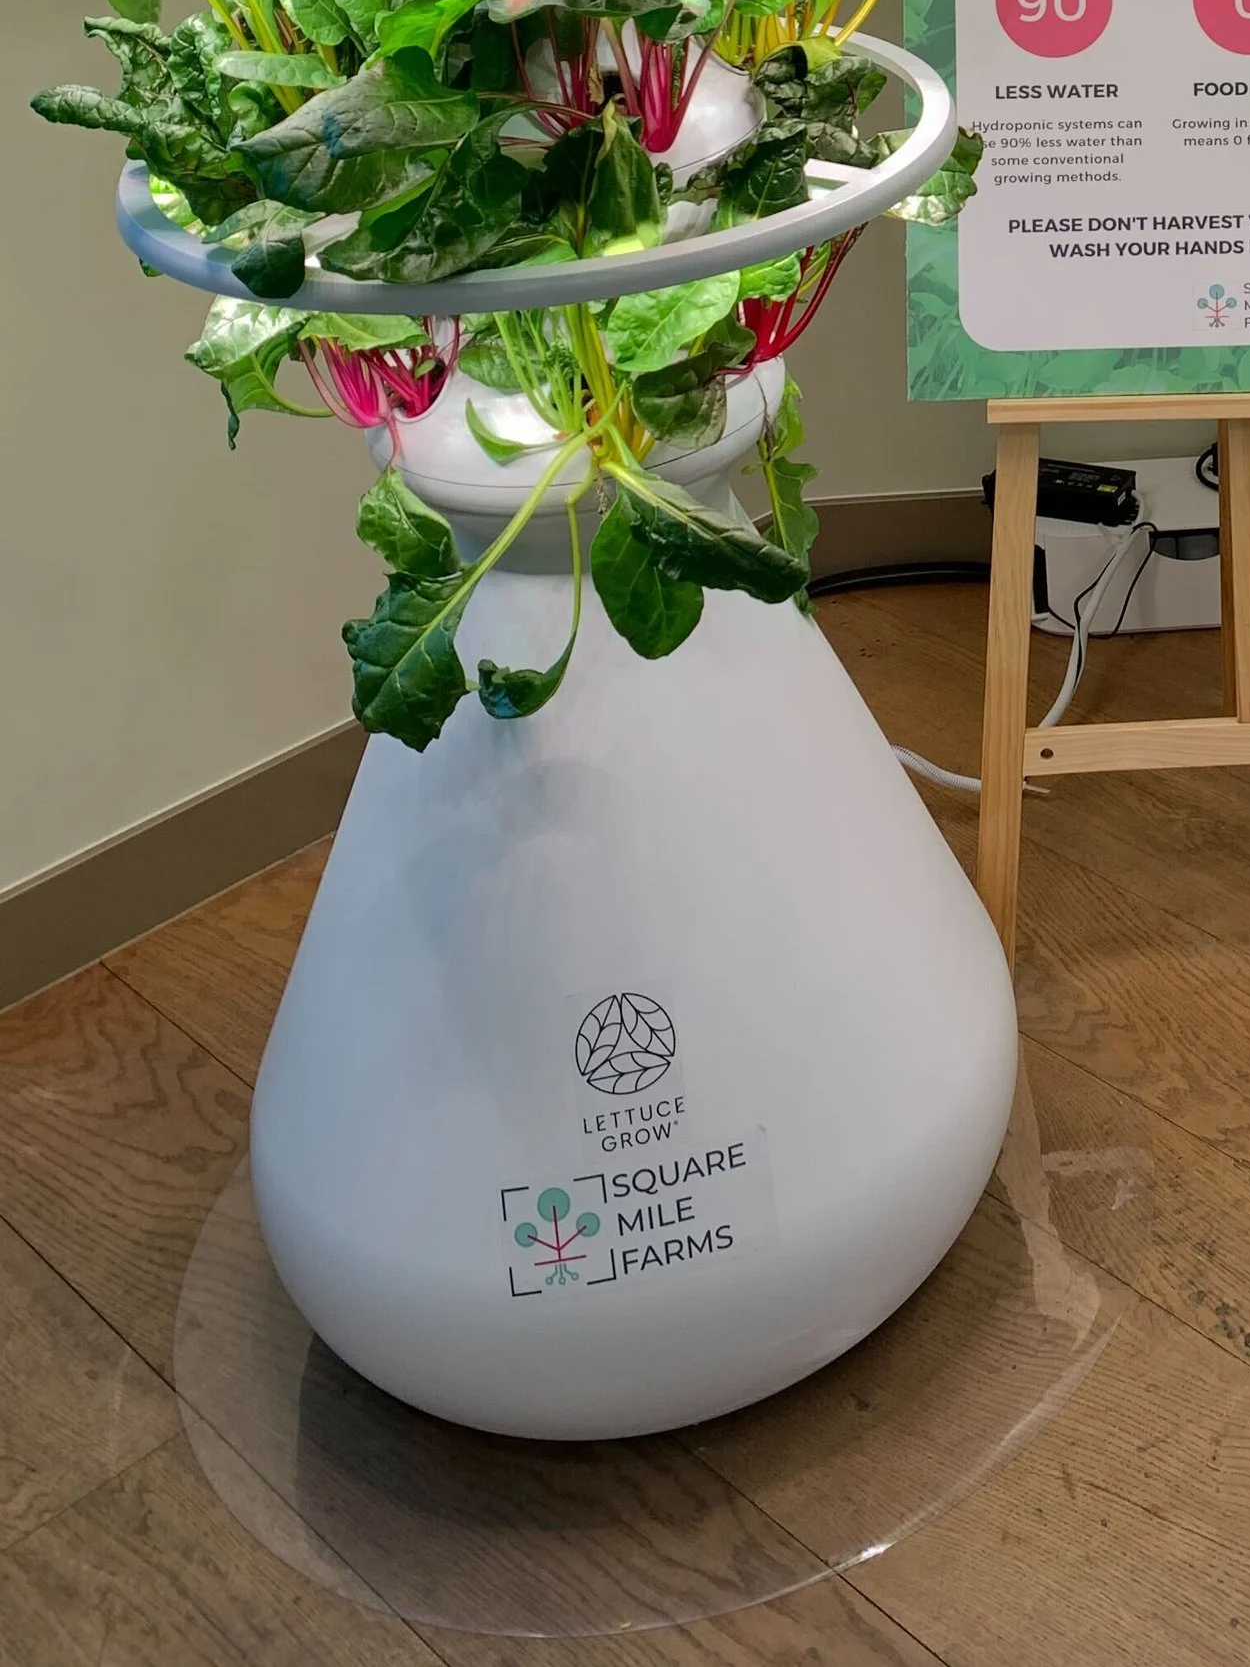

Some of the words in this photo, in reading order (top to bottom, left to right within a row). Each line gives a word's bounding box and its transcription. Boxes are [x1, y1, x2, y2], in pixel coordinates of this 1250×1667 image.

[995, 85, 1041, 100] LESS
[1047, 84, 1118, 98] WATER
[1194, 82, 1248, 96] FOOD
[972, 119, 1053, 133] Hydroponic
[1058, 120, 1113, 132] systems
[1118, 119, 1142, 129] can
[1172, 118, 1230, 130] Growing
[1235, 117, 1247, 128] in
[981, 139, 996, 149] se
[1001, 138, 1032, 148] 90%
[1037, 137, 1062, 147] less
[1067, 137, 1106, 147] water
[1111, 136, 1142, 146] than
[1184, 136, 1229, 146] means
[991, 155, 1028, 166] some
[1033, 153, 1124, 165] conventional
[994, 172, 1051, 185] growing
[1057, 171, 1122, 183] methods.
[1008, 219, 1083, 233] PLEASE
[1088, 217, 1148, 232] DON'T
[1153, 214, 1244, 230] HARVEST
[1049, 242, 1110, 258] WASH
[1115, 242, 1170, 256] YOUR
[1175, 240, 1244, 255] HANDS
[583, 1097, 685, 1134] LETTUCE
[612, 1143, 746, 1197] SQUARE
[618, 1196, 695, 1236] MILE
[622, 1225, 734, 1275] FARMS
